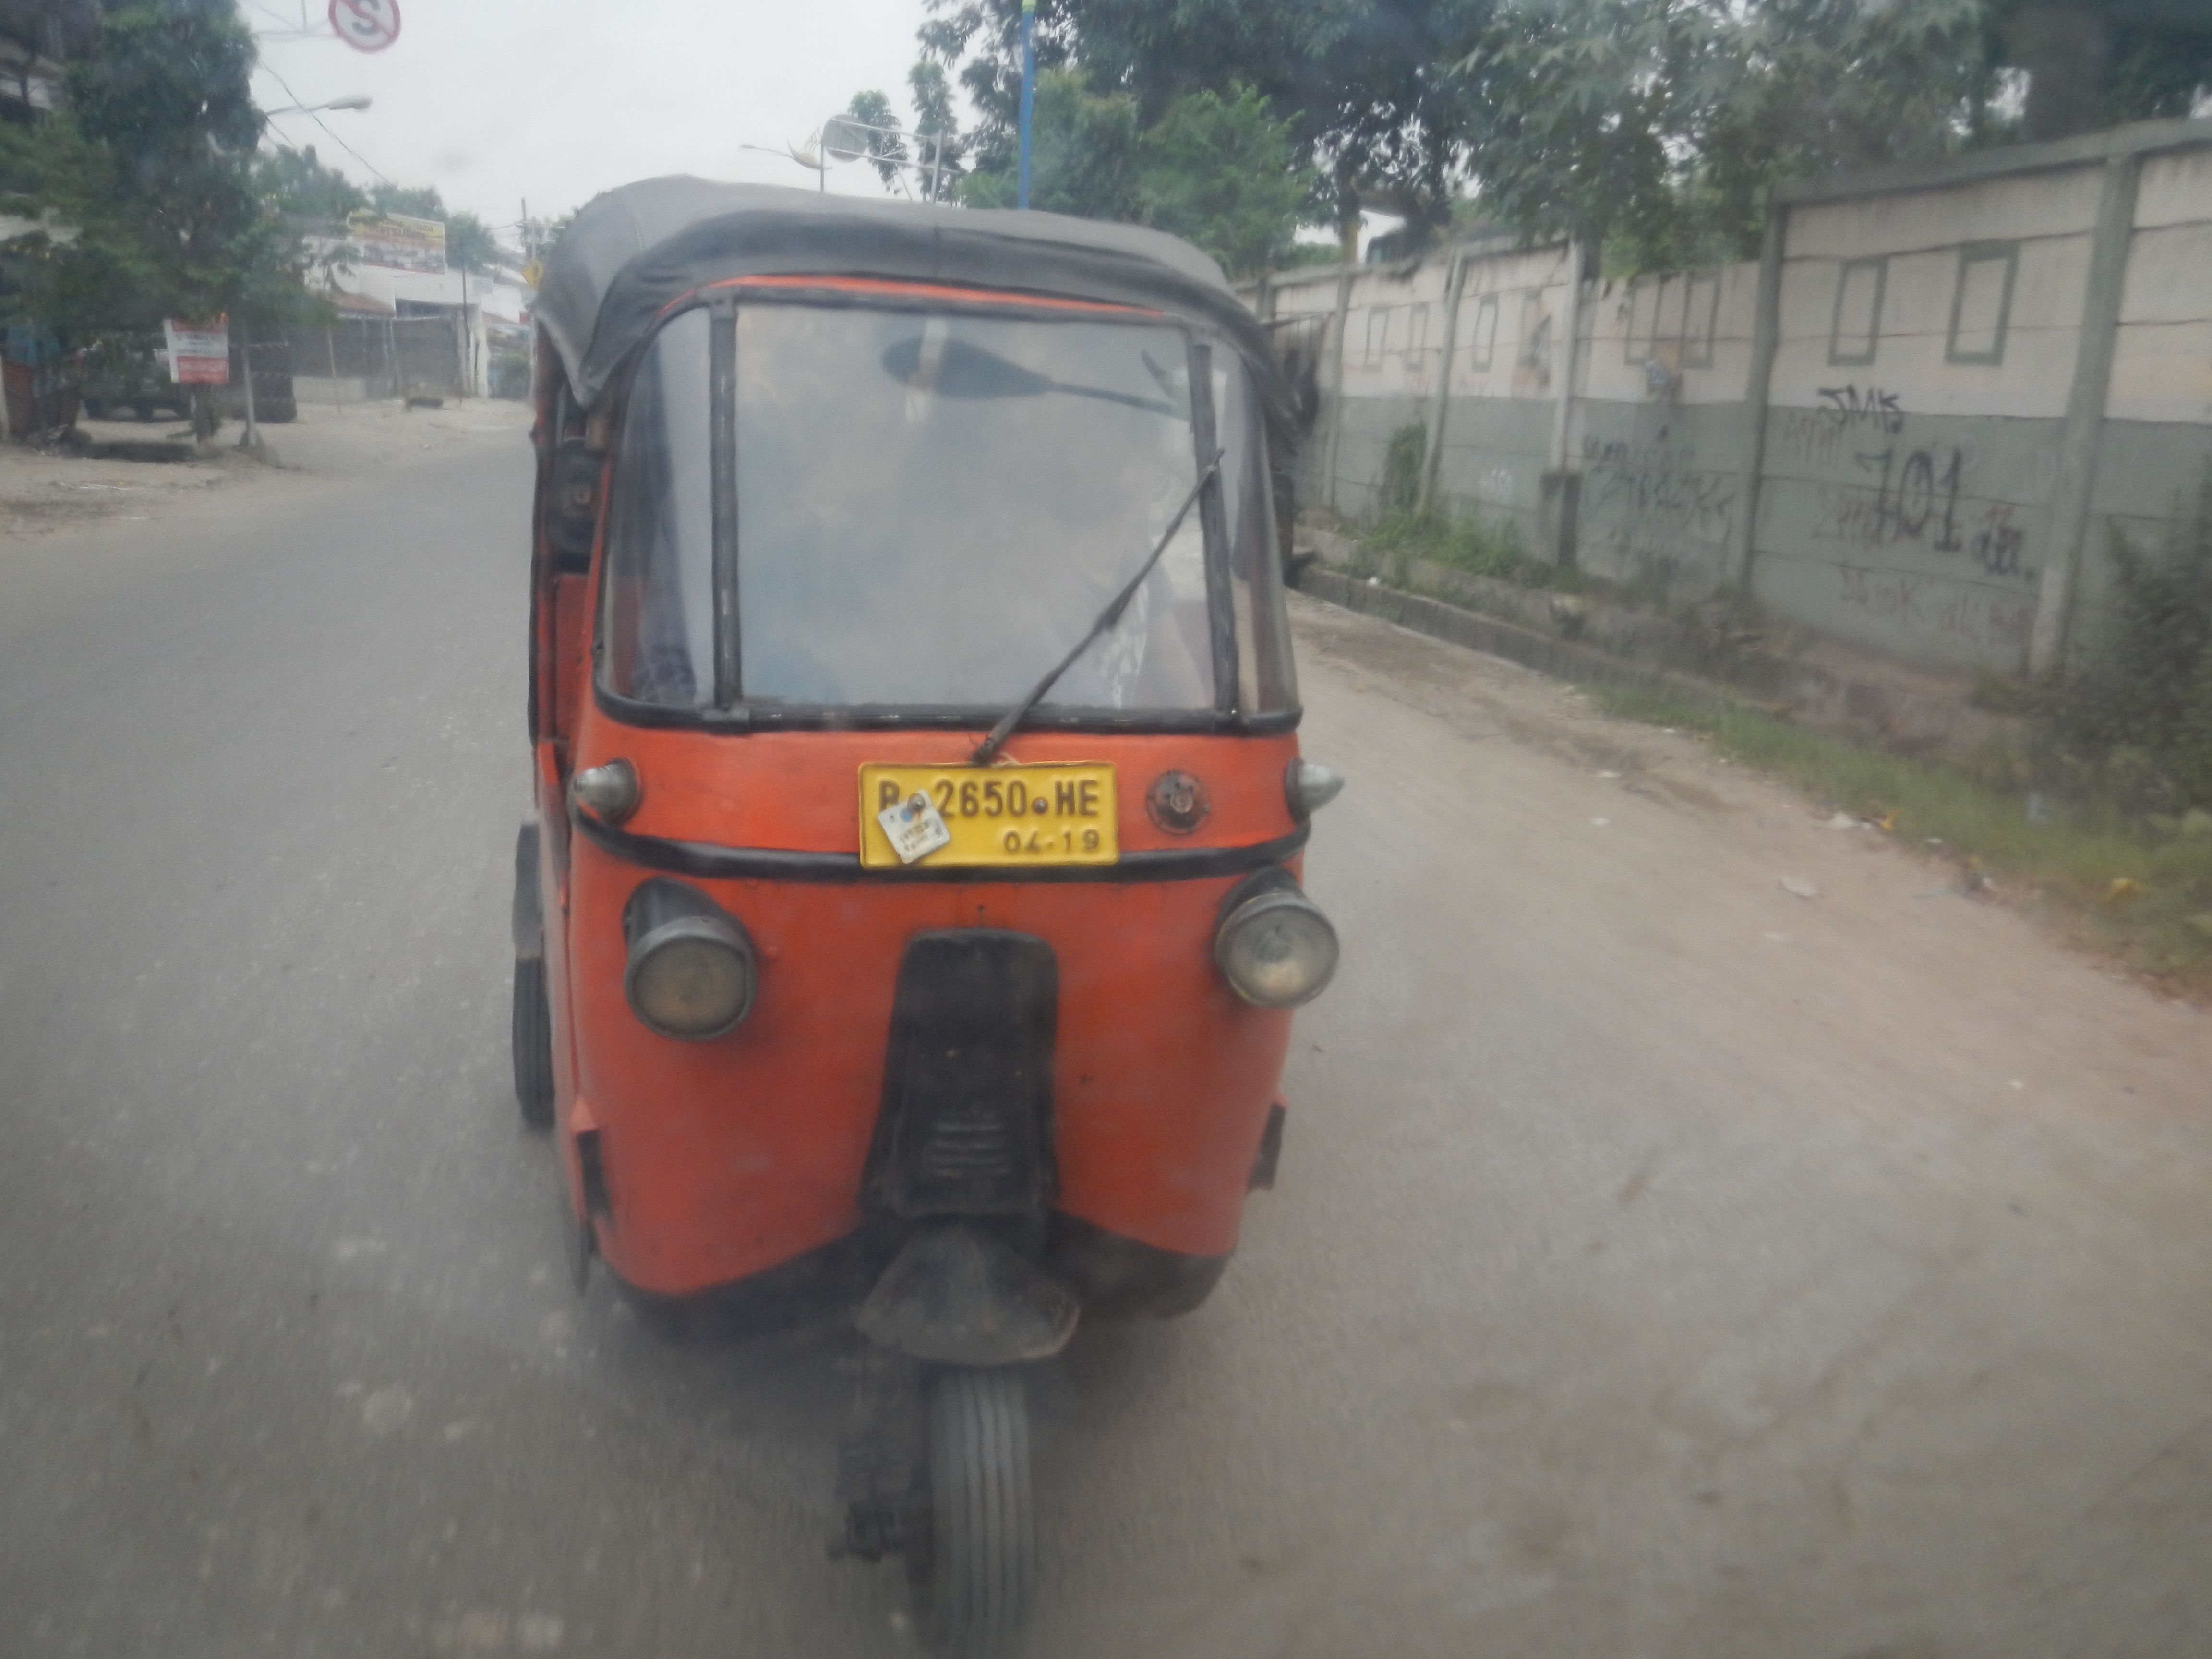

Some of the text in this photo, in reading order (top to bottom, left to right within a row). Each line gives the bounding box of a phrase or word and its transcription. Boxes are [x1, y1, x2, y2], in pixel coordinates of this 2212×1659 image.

[351, 0, 381, 36] S
[934, 779, 1027, 817] 2650
[1055, 779, 1099, 816] HE
